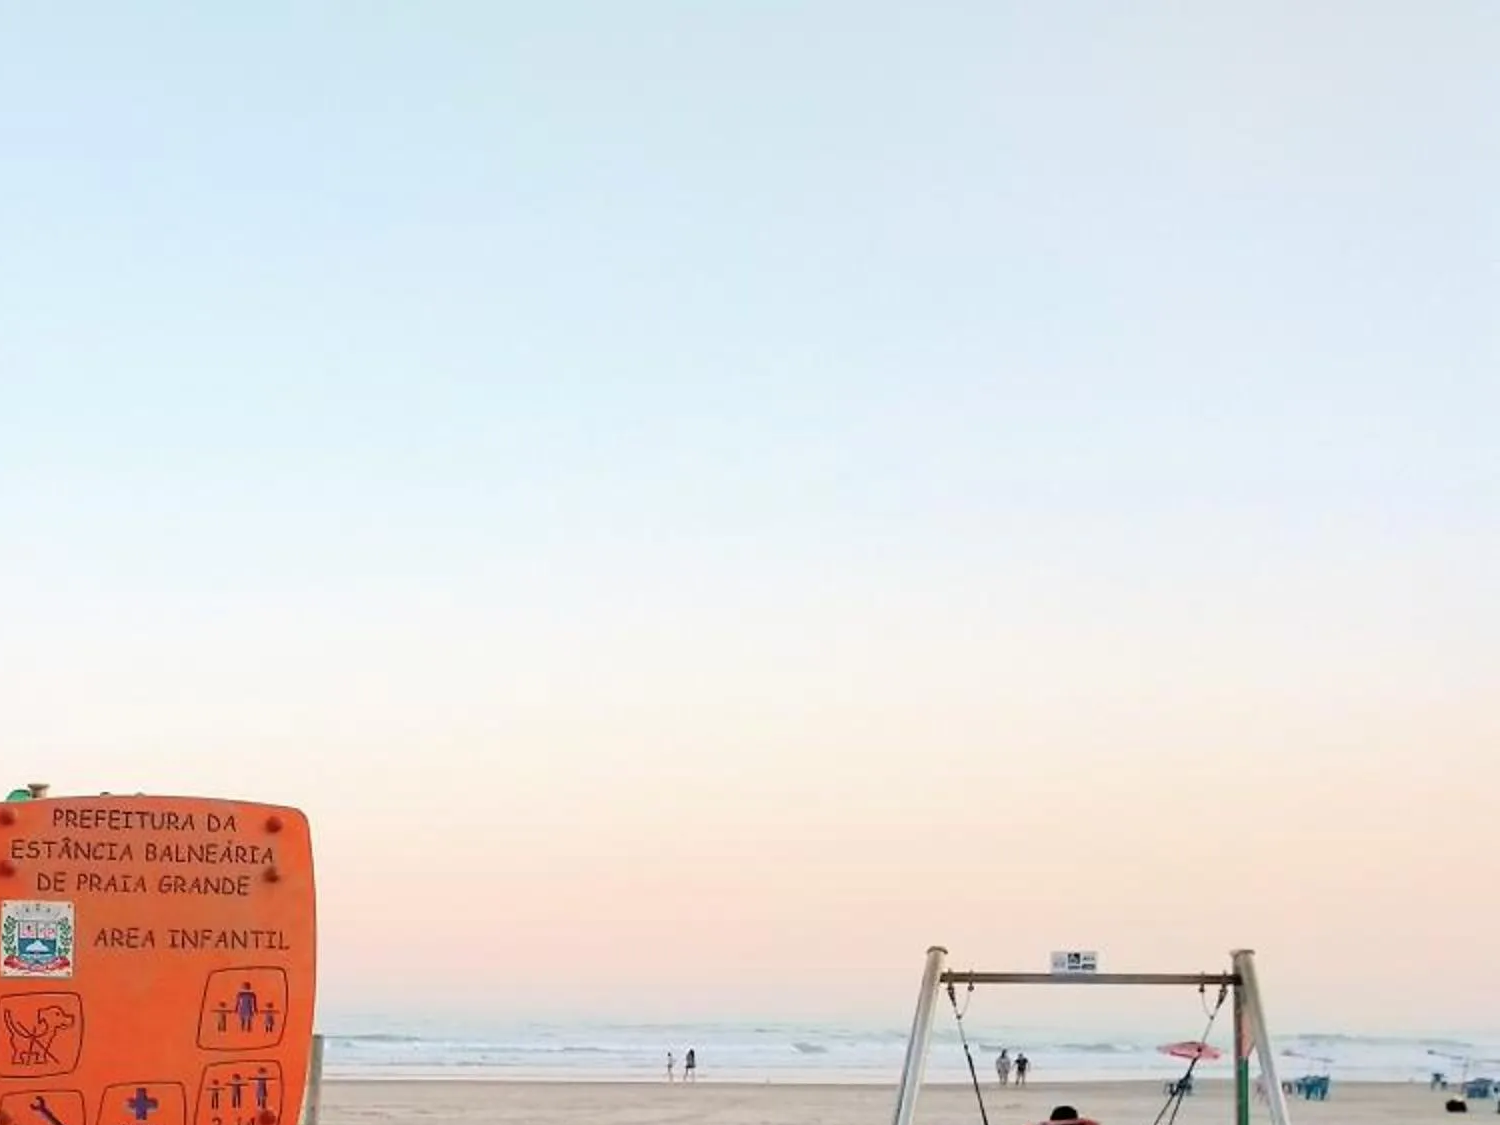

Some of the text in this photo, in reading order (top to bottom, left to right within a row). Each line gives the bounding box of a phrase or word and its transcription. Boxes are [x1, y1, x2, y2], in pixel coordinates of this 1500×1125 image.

[52, 808, 236, 832] PREFEITURA DA
[11, 837, 274, 866] ESTÂNCIA BALNEÁRIA
[37, 872, 251, 896] DE PRAIA GRANDE
[168, 928, 290, 951] INFANTIL
